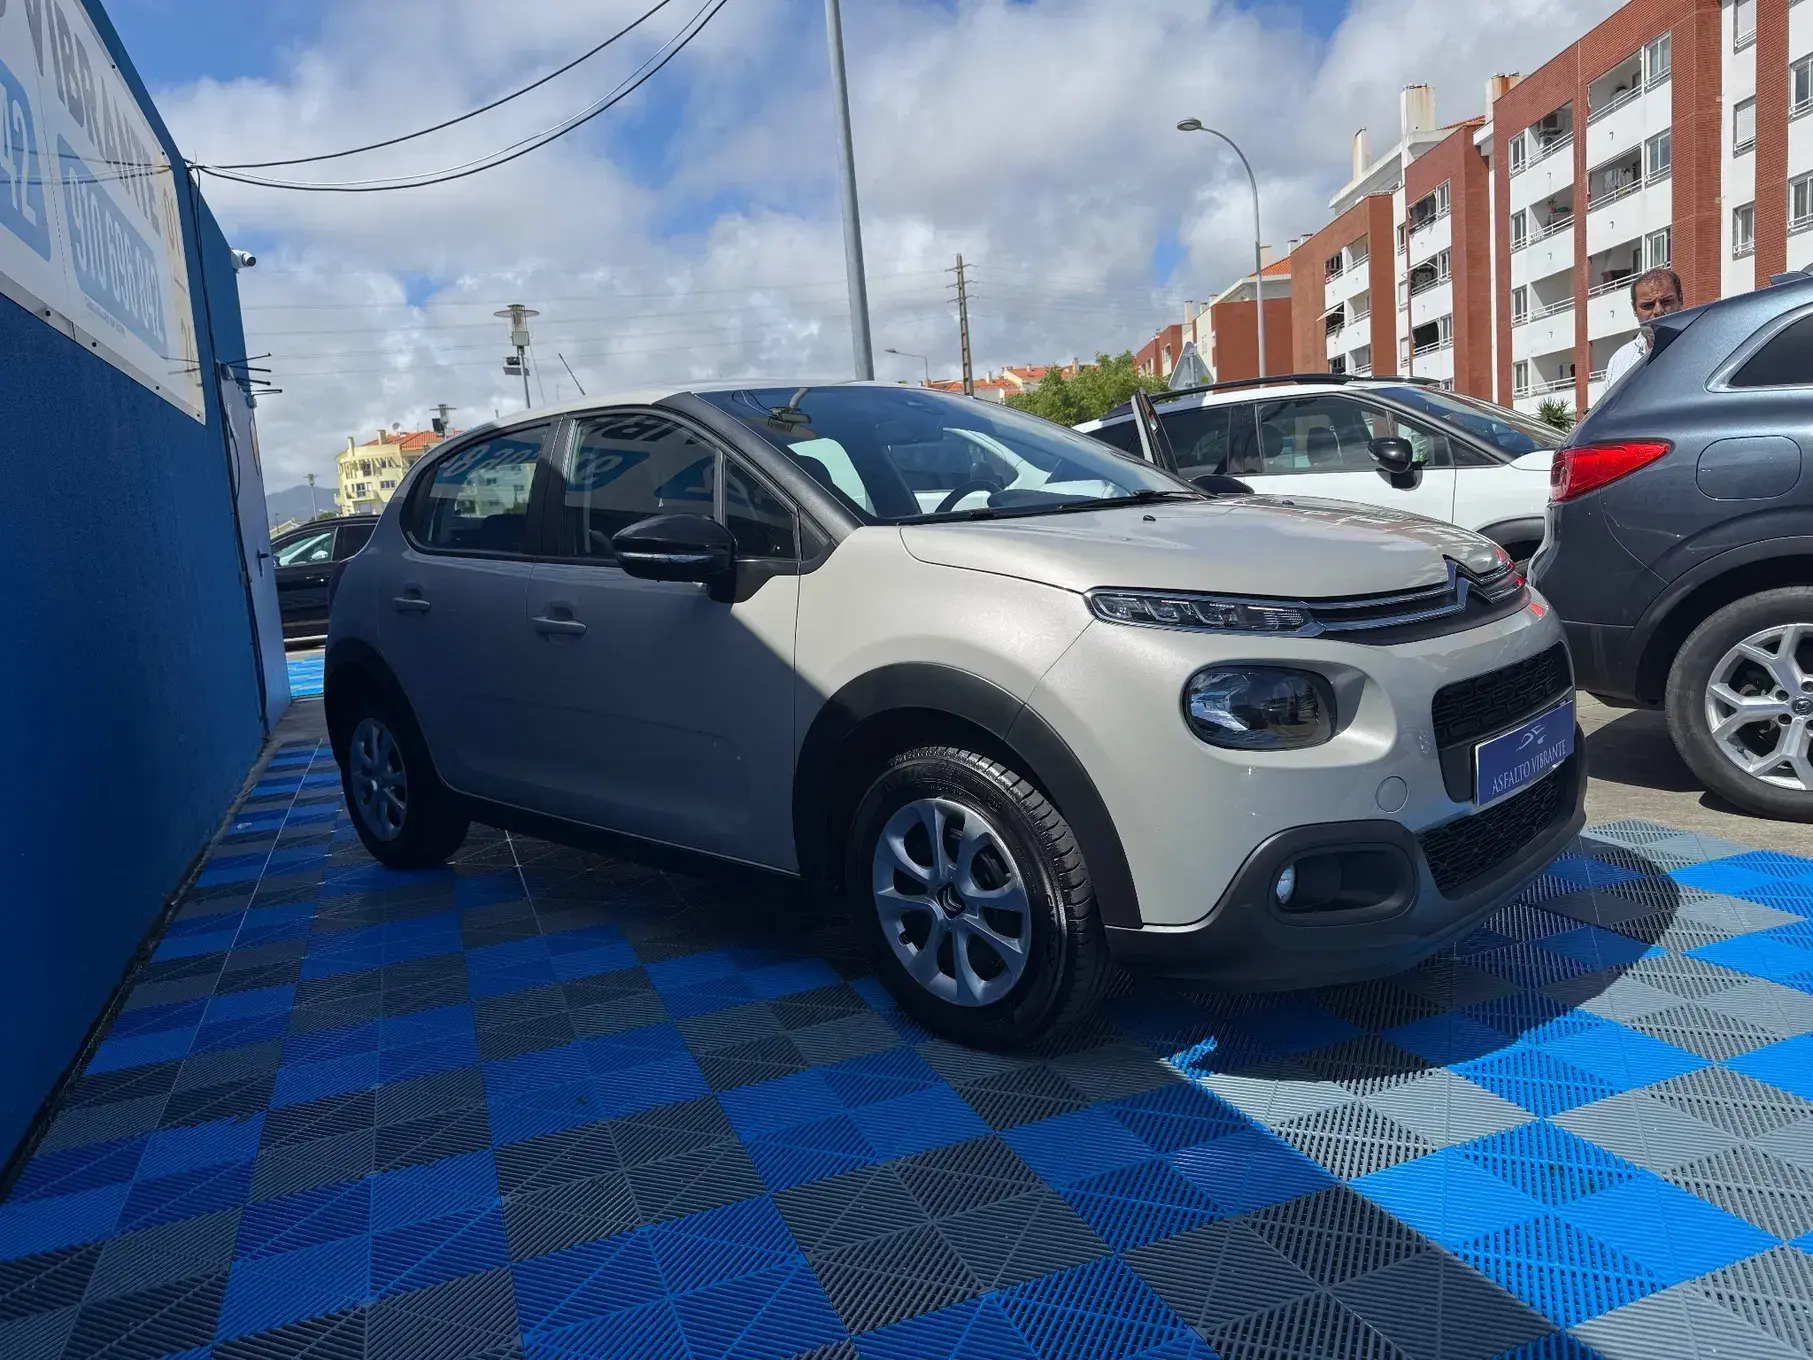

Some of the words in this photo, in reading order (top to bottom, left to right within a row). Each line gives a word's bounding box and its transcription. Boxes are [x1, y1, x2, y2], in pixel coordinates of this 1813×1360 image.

[69, 166, 107, 291] 910
[105, 208, 139, 321] 696
[1492, 761, 1530, 795] ASFALTO
[1531, 739, 1566, 773] VIBRANTE
